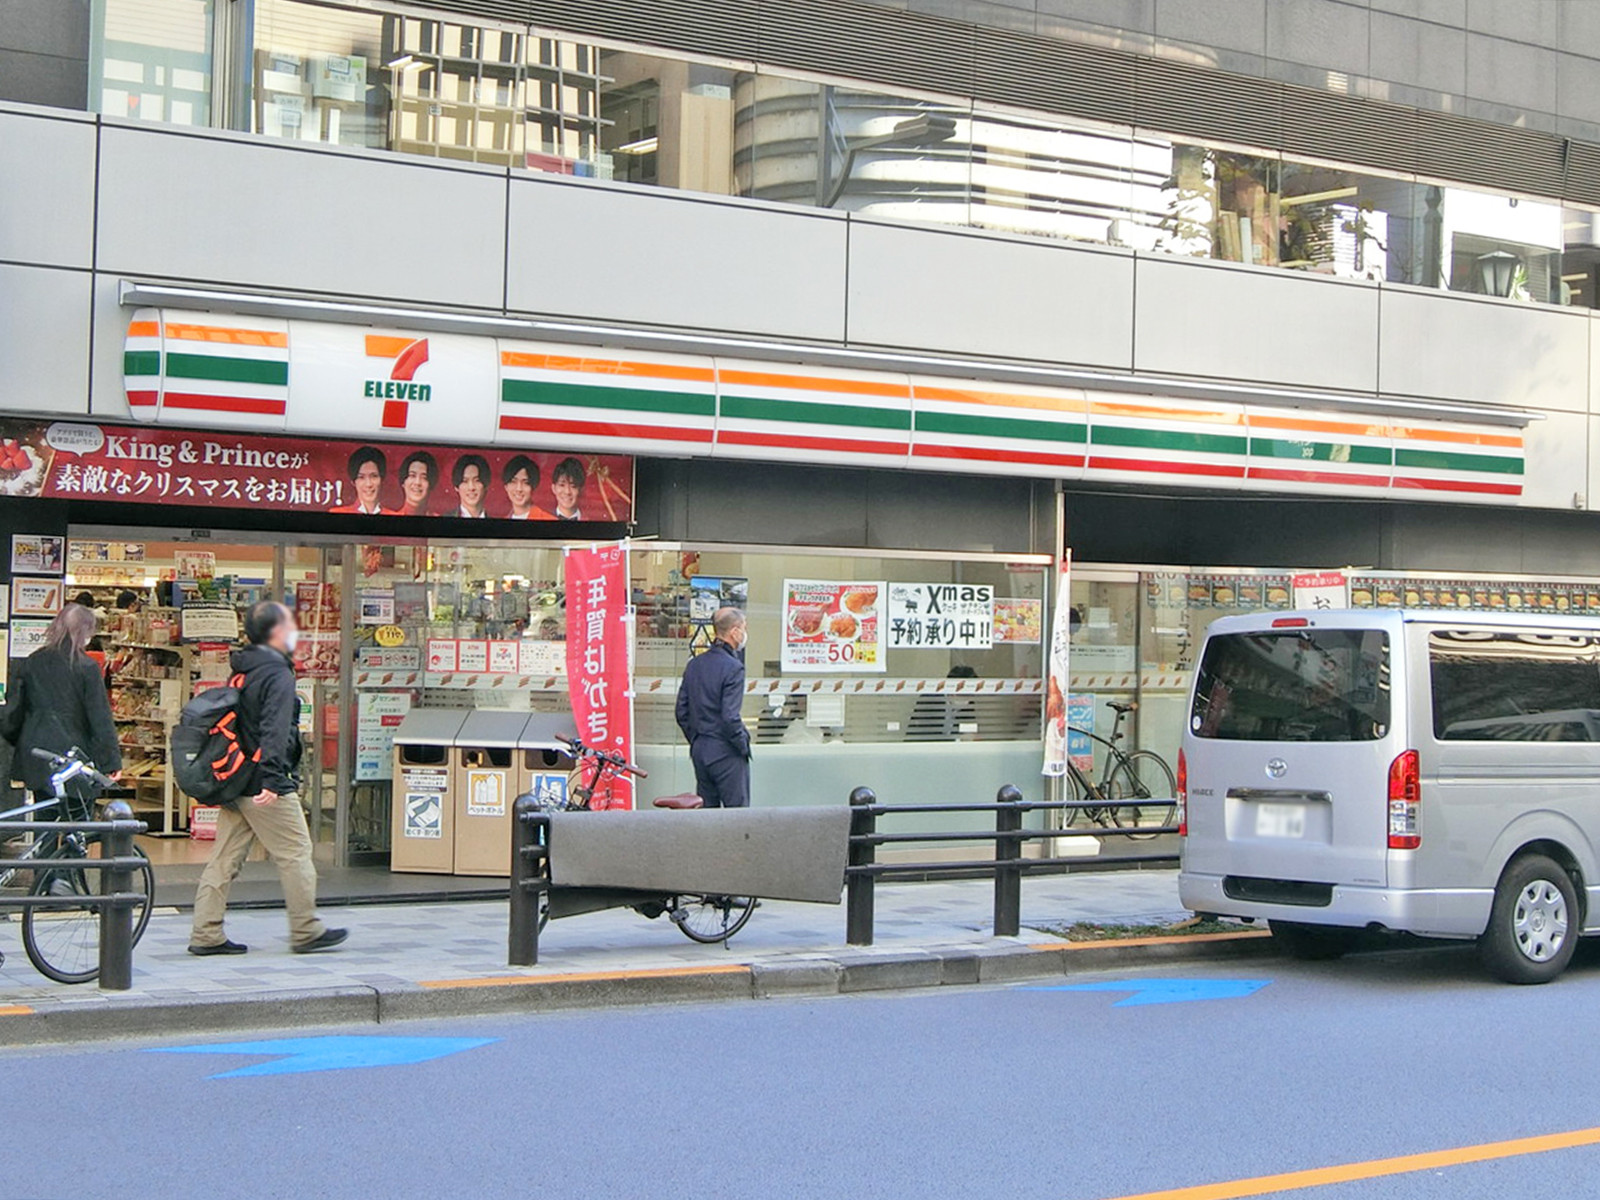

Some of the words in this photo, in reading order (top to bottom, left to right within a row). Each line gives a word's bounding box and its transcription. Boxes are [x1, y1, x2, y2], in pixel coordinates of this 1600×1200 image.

[105, 434, 175, 467] King
[178, 442, 198, 465] &
[55, 463, 344, 507] 素敵なクリスマスをお届け!
[926, 585, 990, 614] Xmas
[890, 617, 991, 646] 予約承り中!!
[1191, 788, 1214, 797] HIACE
[469, 806, 504, 814] ペットボトル
